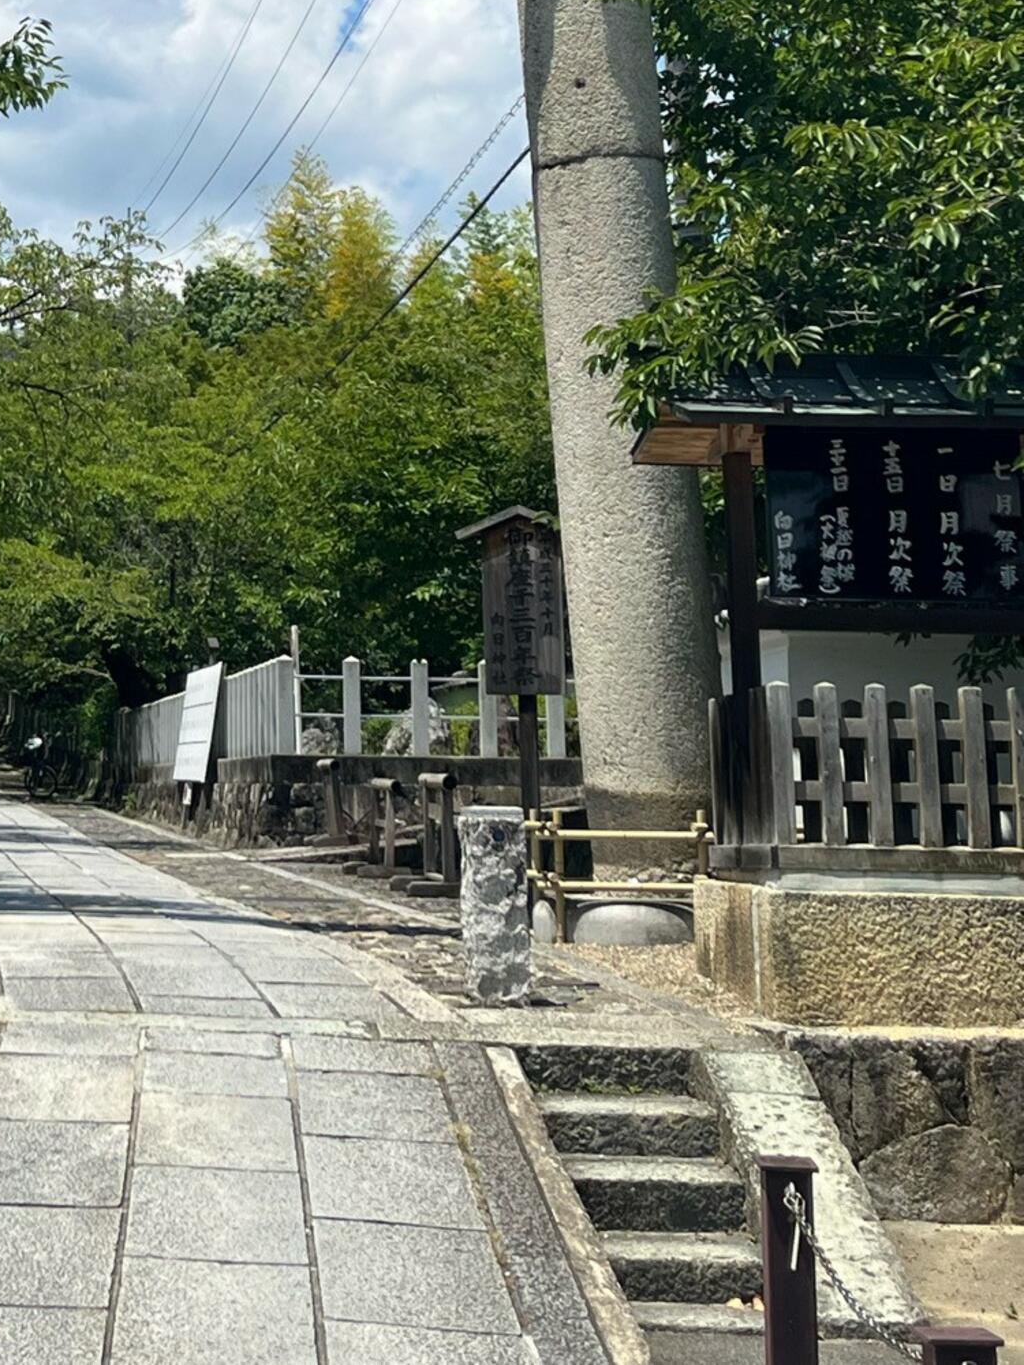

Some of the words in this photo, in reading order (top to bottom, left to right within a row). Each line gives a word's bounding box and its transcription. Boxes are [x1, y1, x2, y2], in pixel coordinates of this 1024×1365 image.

[882, 440, 904, 493] 十五日
[937, 446, 957, 492] 一日
[774, 510, 802, 592] 向日神社
[888, 509, 914, 593] 月次祭
[940, 511, 966, 596] 月次祭
